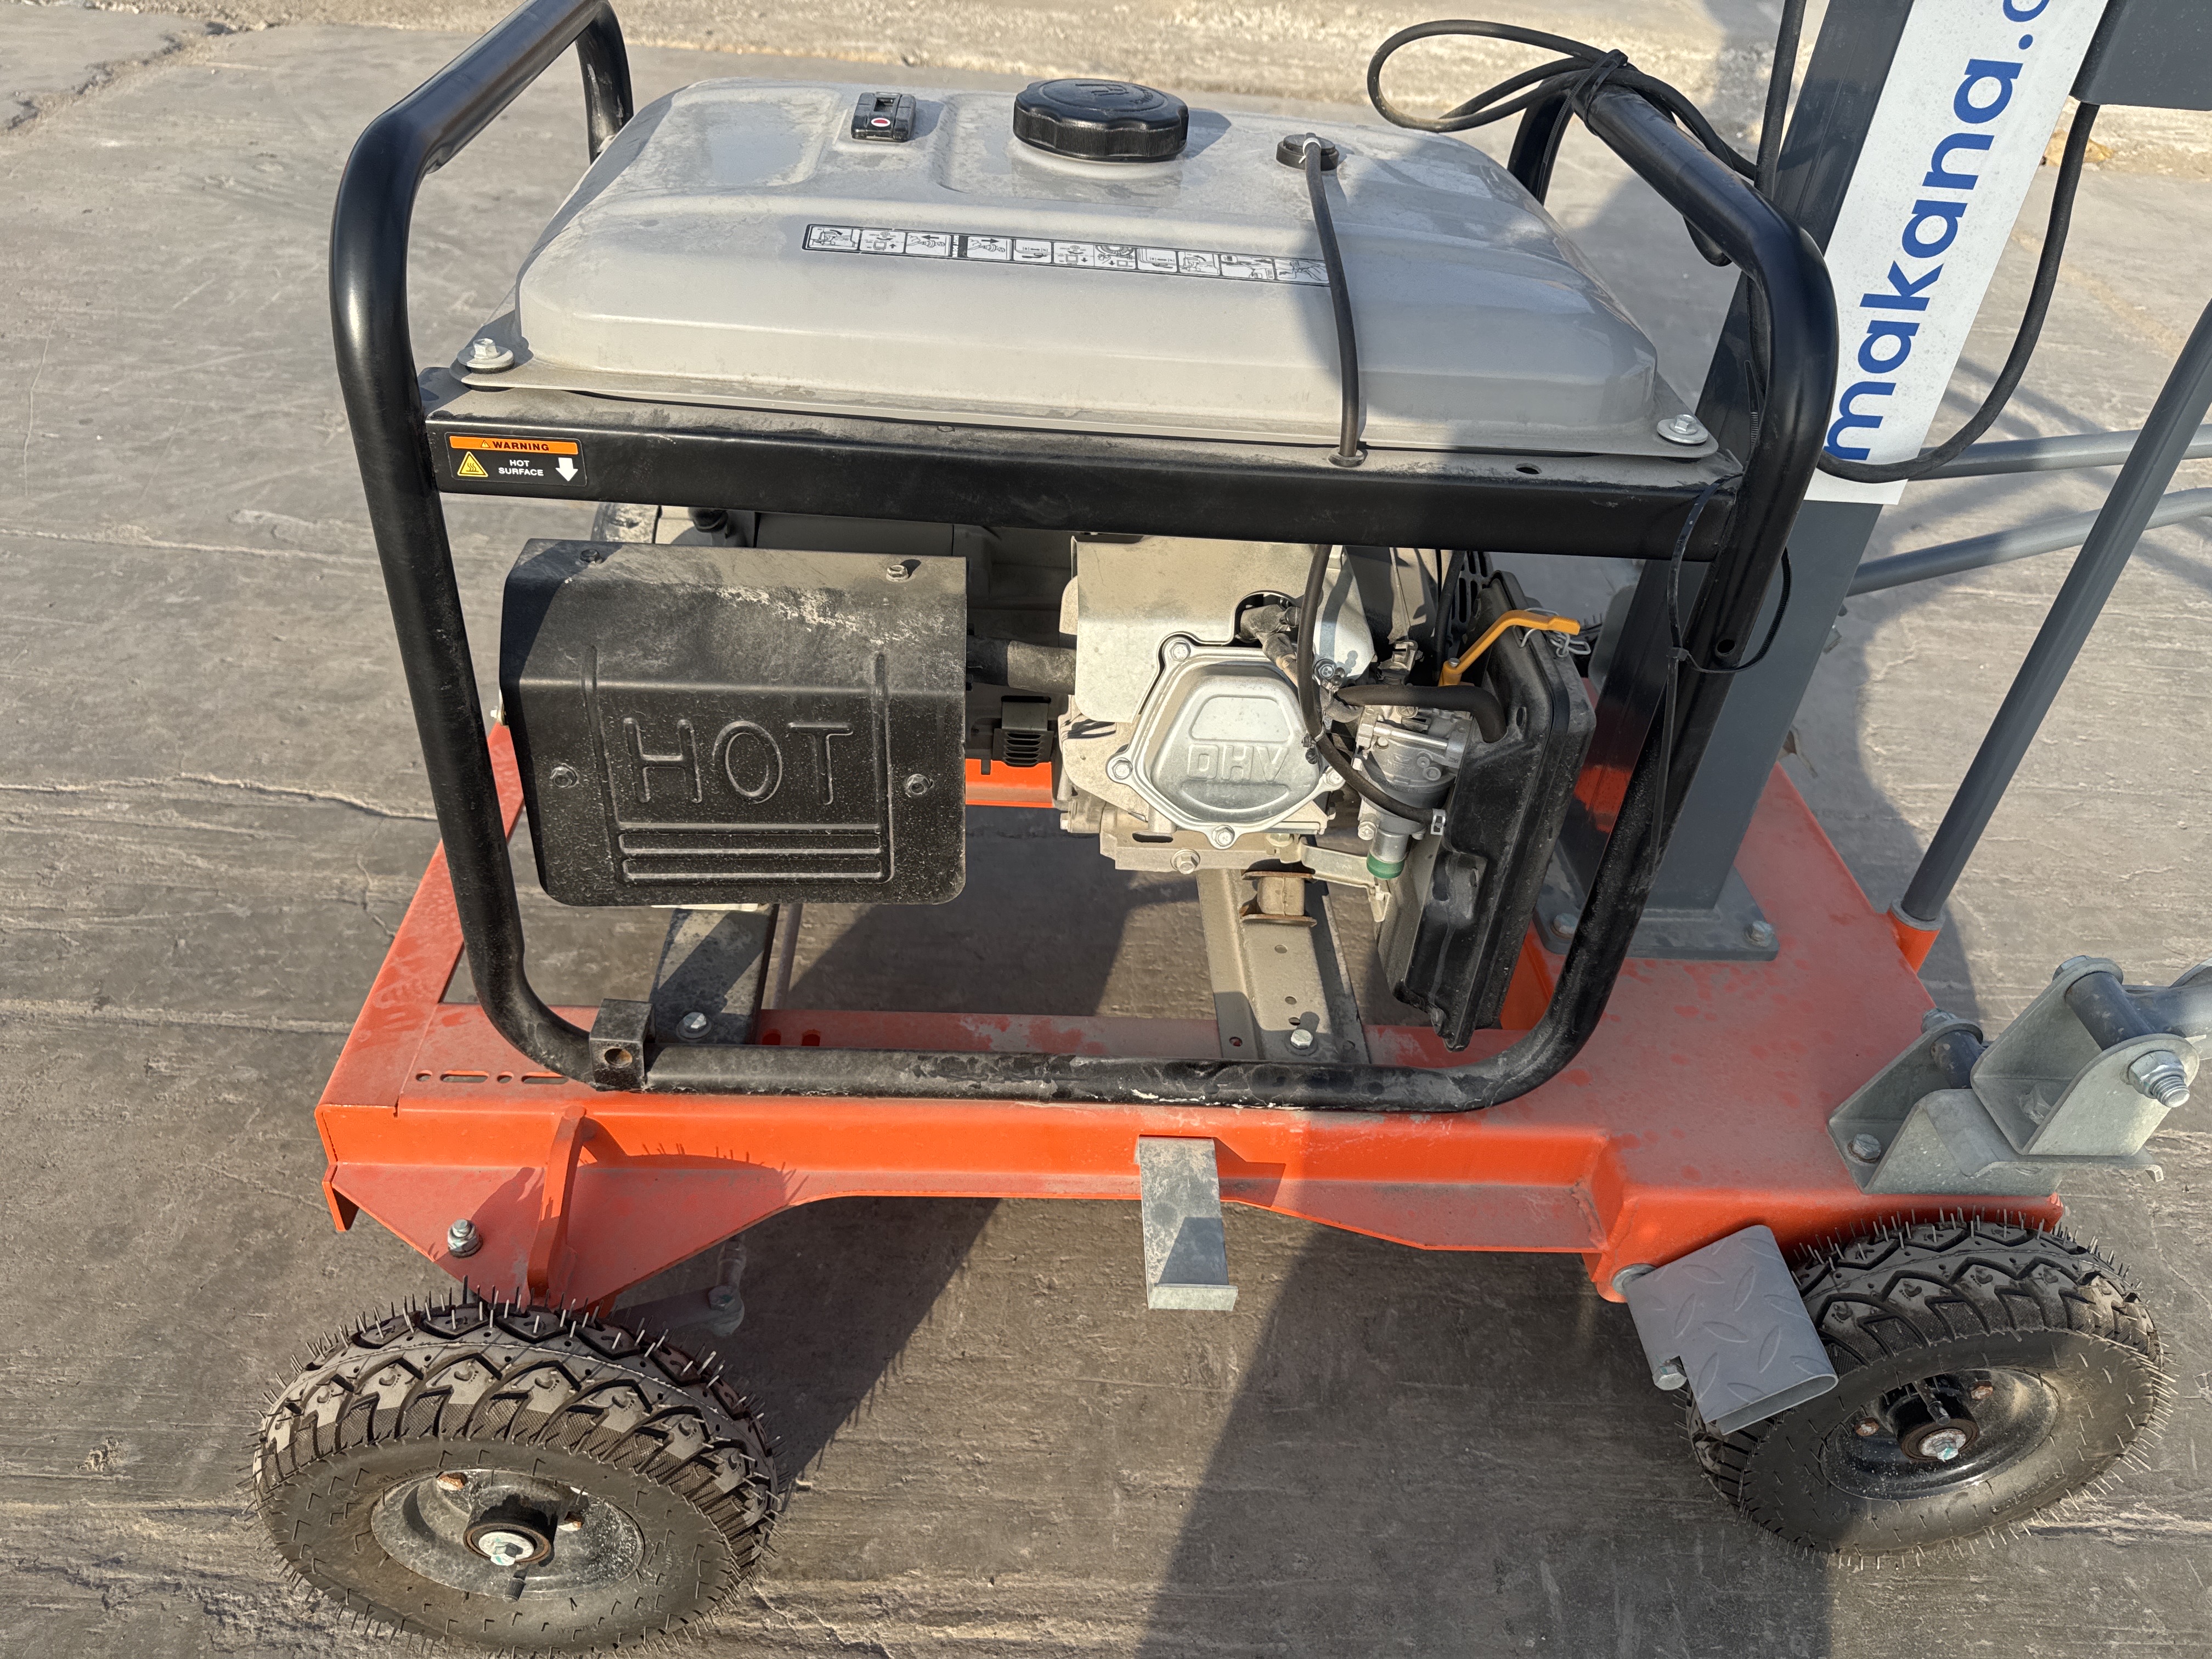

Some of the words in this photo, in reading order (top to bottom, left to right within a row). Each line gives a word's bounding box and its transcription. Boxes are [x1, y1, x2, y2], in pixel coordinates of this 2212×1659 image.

[492, 441, 549, 452] WARNING
[498, 467, 544, 476] SURFACE
[623, 717, 854, 805] HOT
[1186, 743, 1289, 782] OHV
